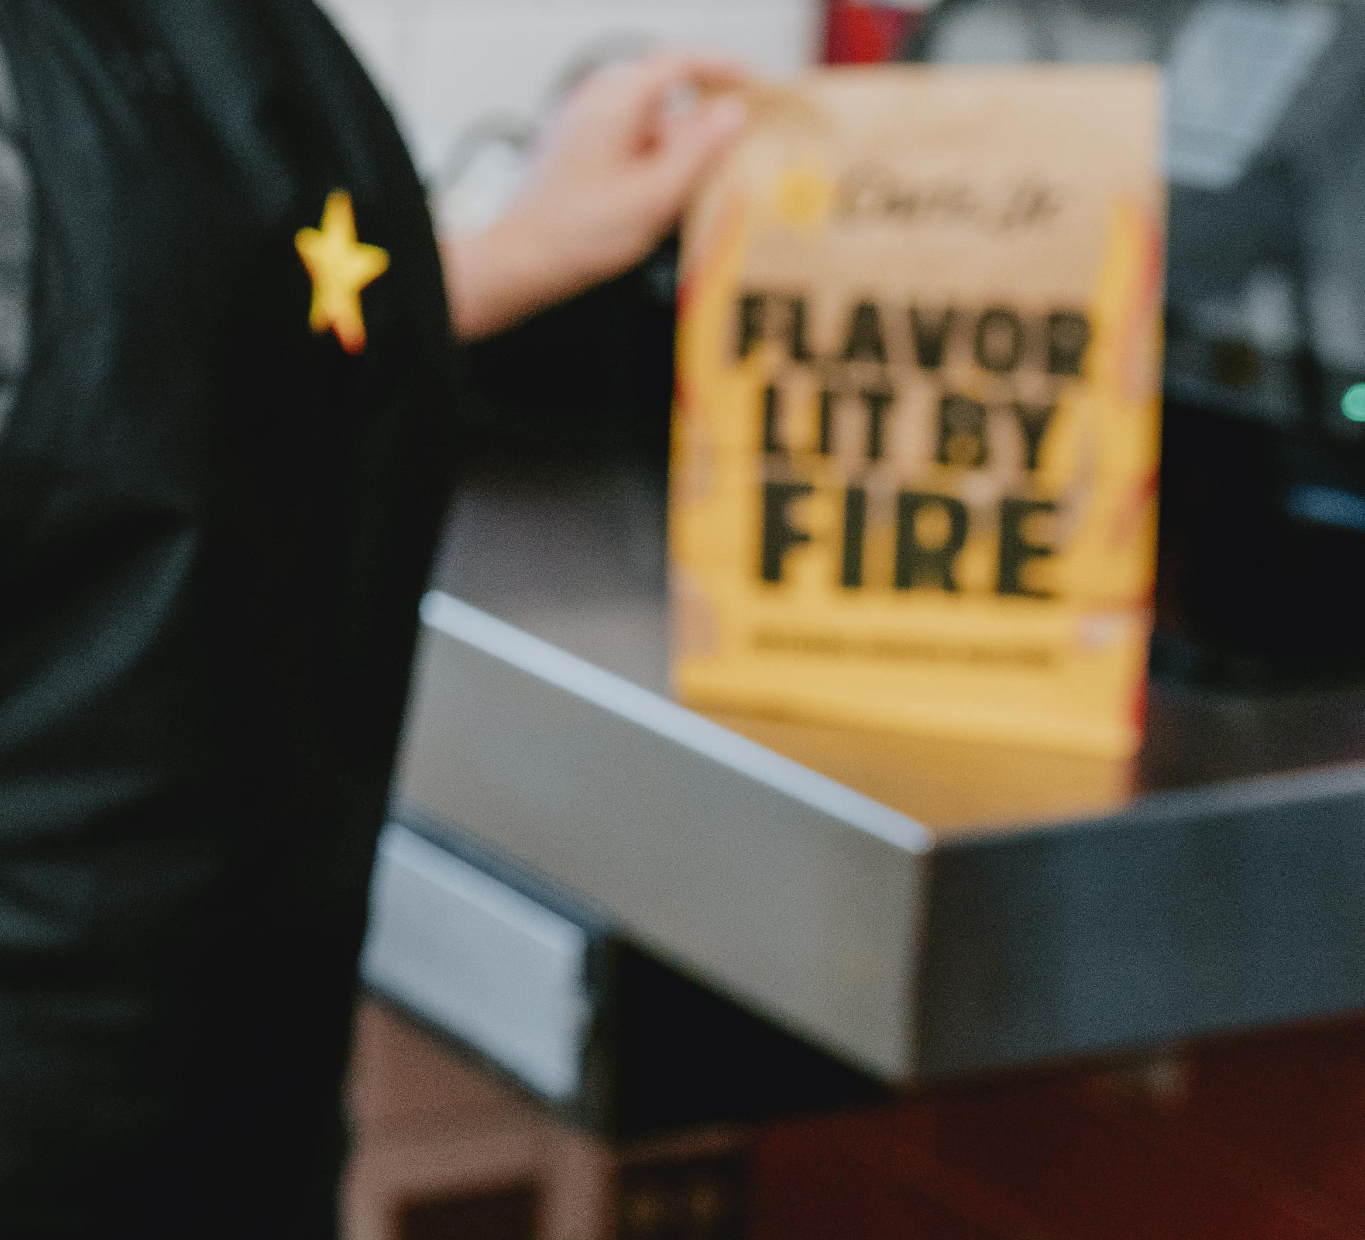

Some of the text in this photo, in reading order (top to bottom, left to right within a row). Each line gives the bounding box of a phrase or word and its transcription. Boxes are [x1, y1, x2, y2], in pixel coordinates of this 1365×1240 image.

[734, 290, 1093, 380] FLAVOR
[761, 382, 1057, 472] LIT BY
[760, 481, 1062, 601] FIRE
